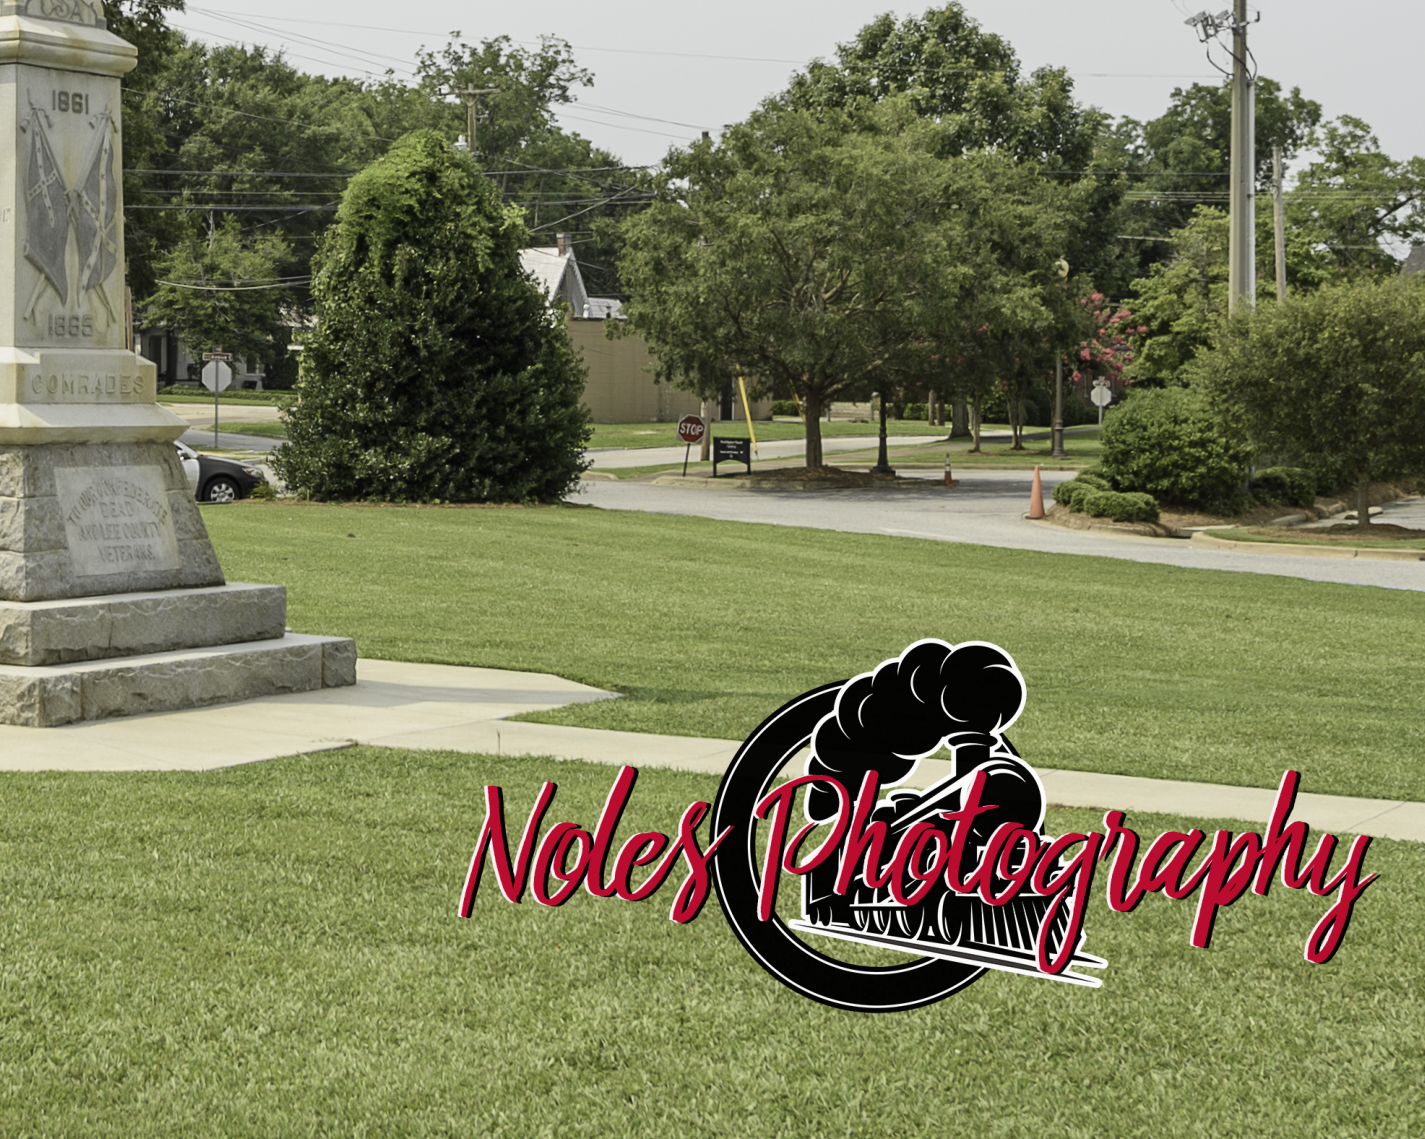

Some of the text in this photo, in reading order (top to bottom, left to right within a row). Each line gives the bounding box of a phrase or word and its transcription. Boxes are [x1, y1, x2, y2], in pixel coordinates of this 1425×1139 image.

[52, 89, 89, 115] 1861
[47, 313, 94, 338] 1865
[31, 372, 145, 395] COMRADES
[679, 423, 704, 435] STOP
[99, 523, 122, 540] LEE
